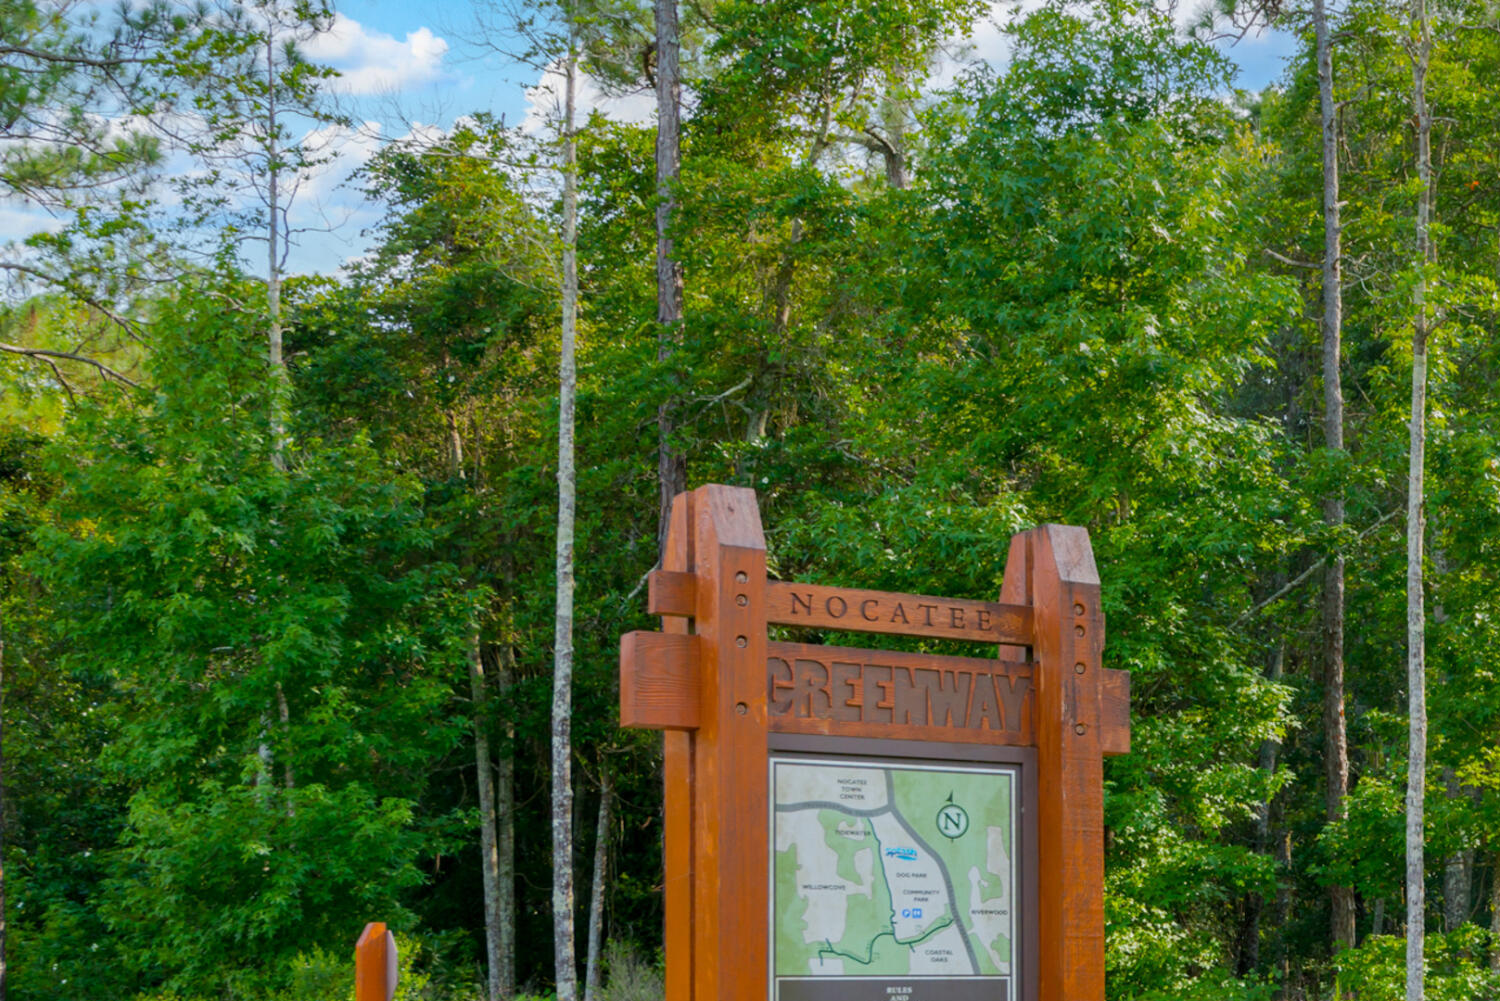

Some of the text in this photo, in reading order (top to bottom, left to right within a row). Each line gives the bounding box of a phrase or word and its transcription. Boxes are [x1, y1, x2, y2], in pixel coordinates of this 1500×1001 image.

[790, 591, 993, 632] NOCATEE
[767, 655, 1032, 733] GREENWAY
[839, 793, 865, 801] CENTER
[886, 986, 912, 994] RULES
[890, 994, 909, 1001] AND
